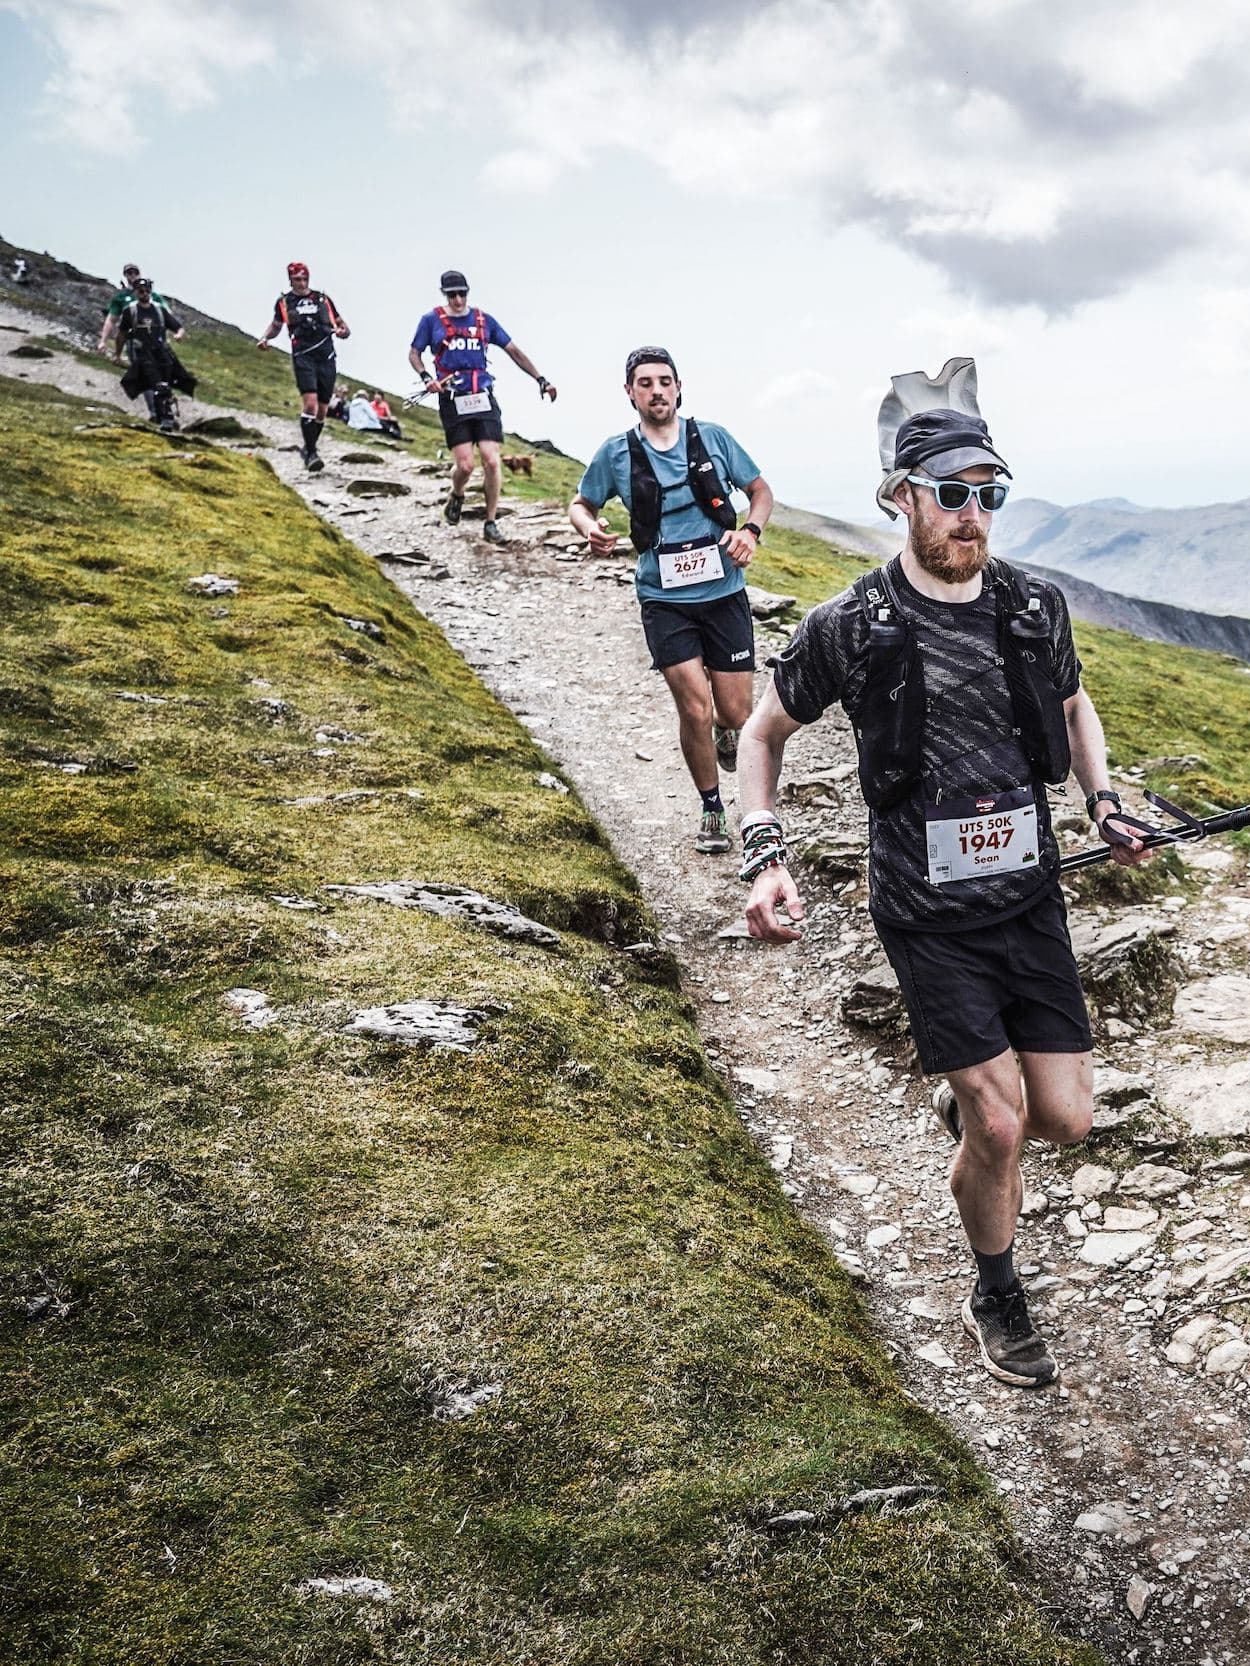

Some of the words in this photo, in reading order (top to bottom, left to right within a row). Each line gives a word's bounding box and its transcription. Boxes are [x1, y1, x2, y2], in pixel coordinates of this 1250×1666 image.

[674, 557, 706, 573] 2677
[959, 821, 983, 834] UTS
[987, 816, 1012, 830] 50K
[959, 828, 1015, 855] 1947
[974, 855, 1000, 865] Sean
